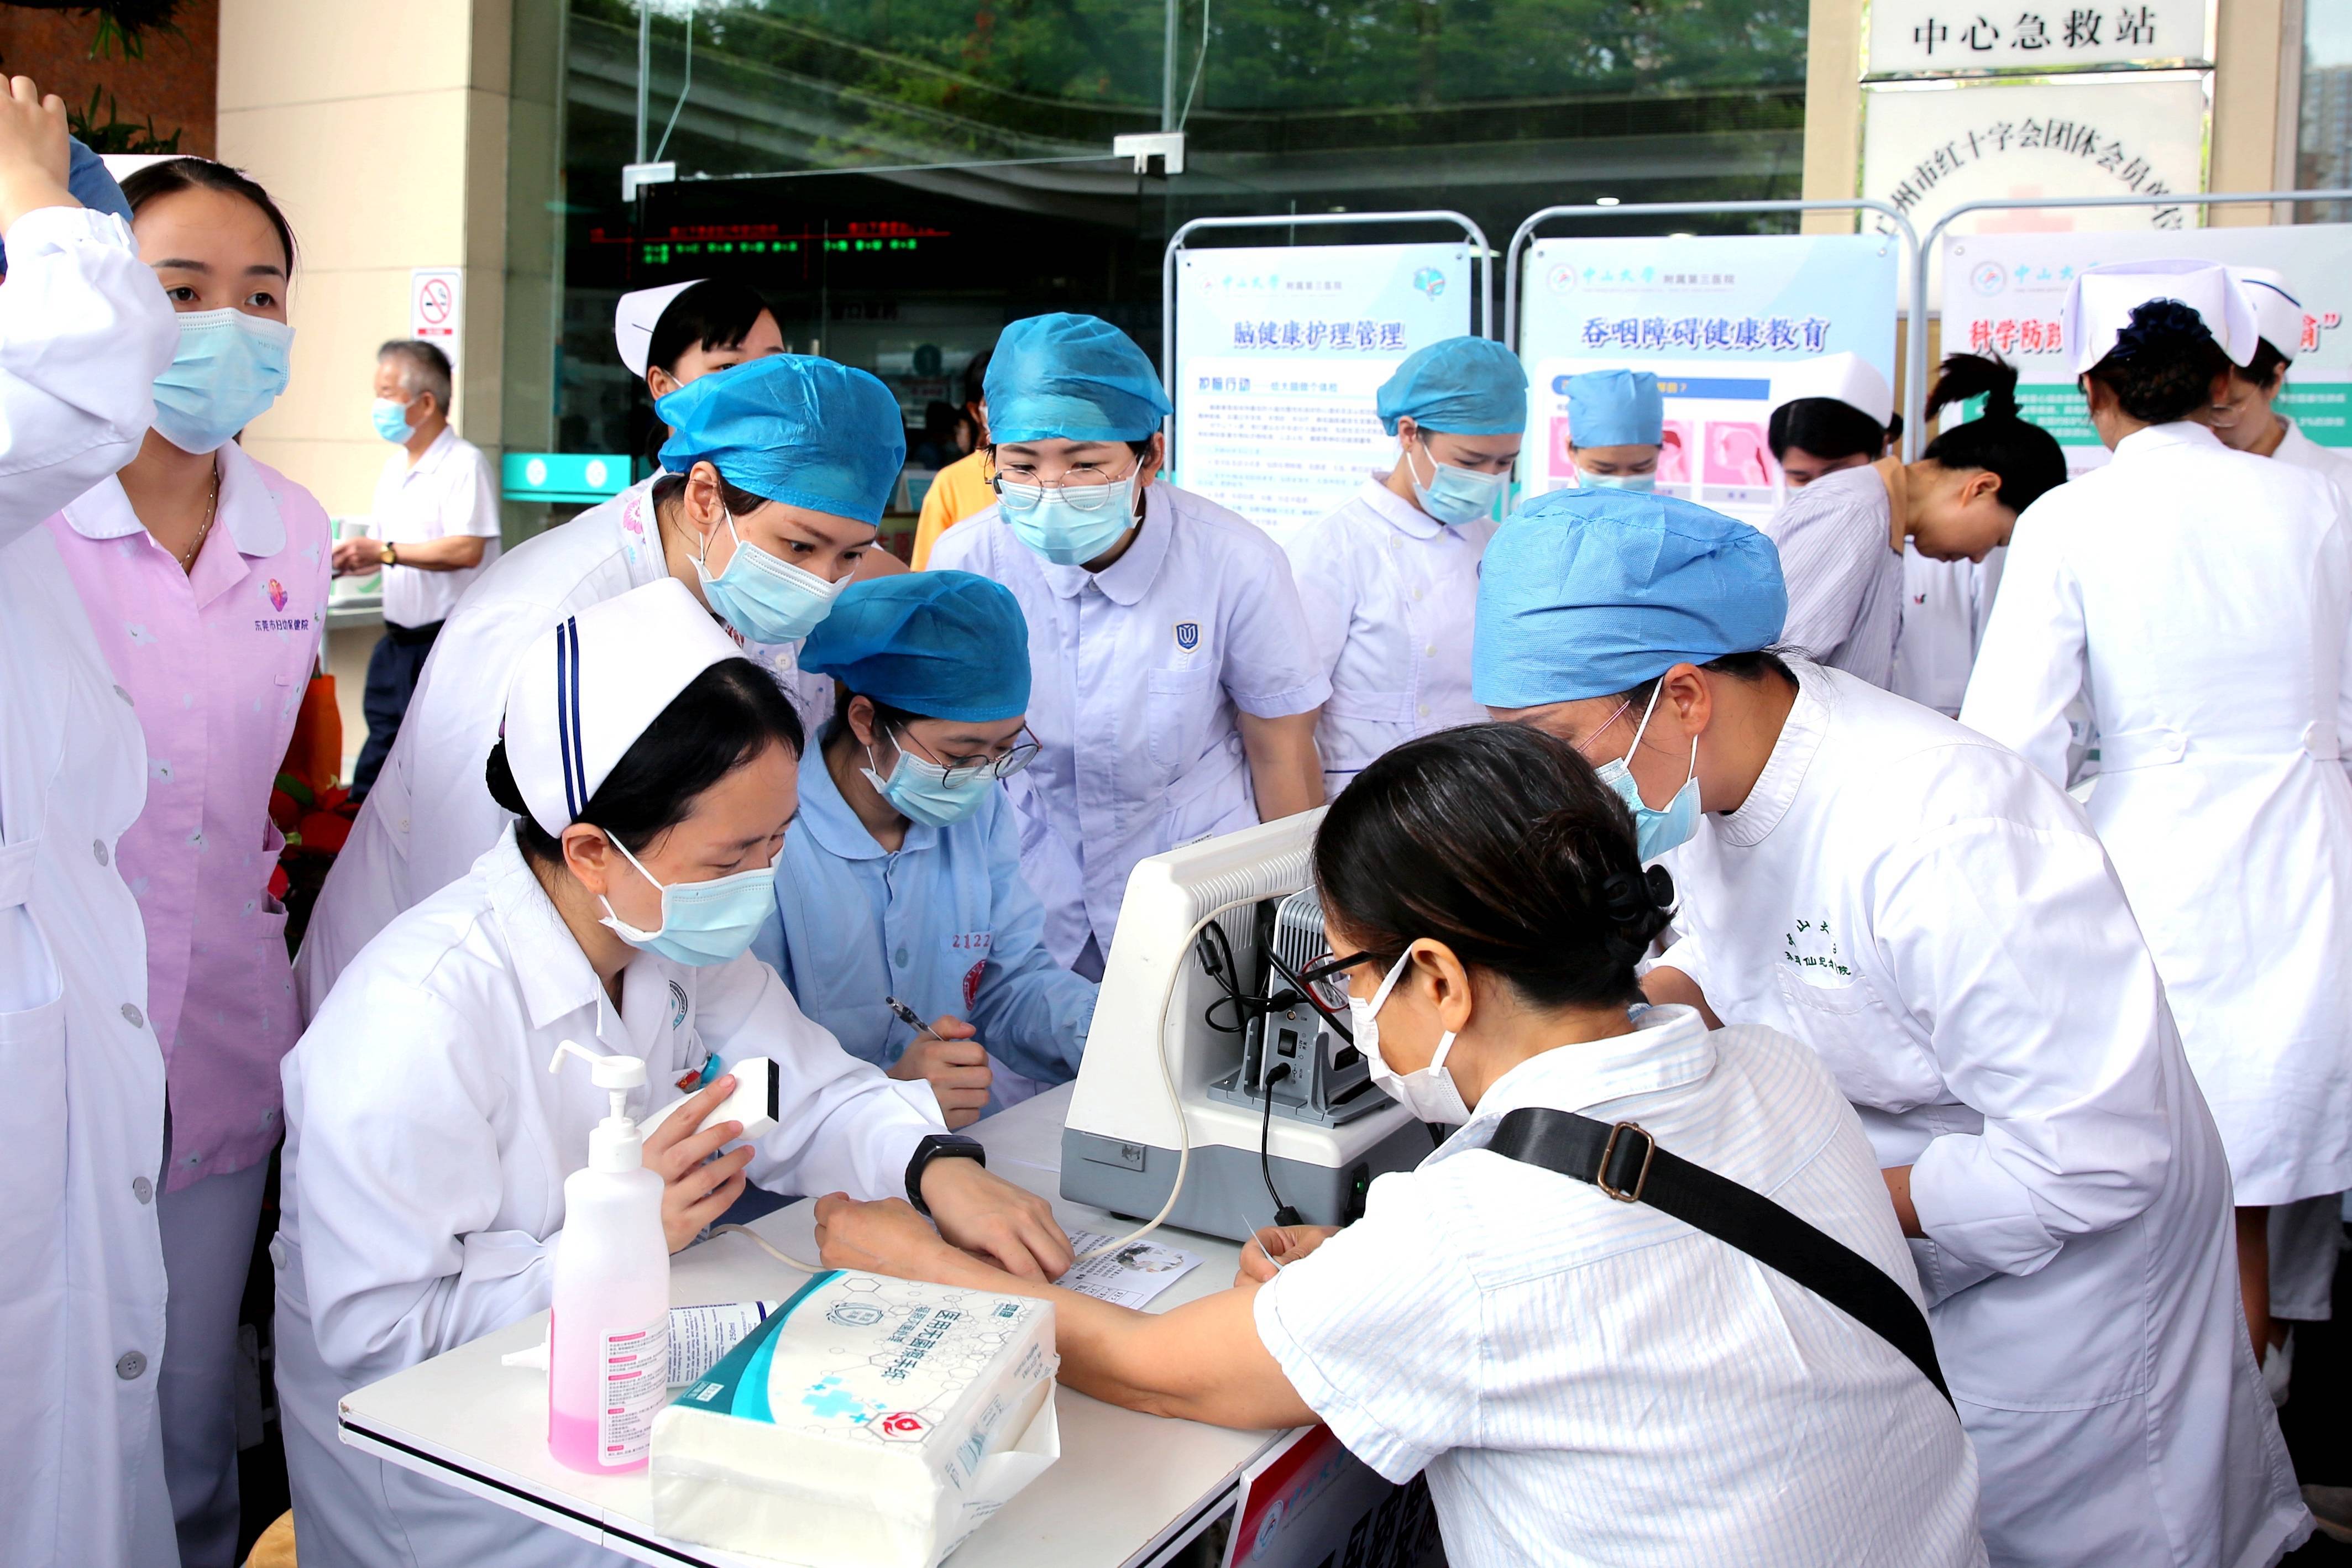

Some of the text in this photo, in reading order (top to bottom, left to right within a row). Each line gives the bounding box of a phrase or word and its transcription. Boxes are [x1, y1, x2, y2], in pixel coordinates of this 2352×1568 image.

[1914, 6, 2156, 55] 中心急救站
[1233, 319, 1405, 348] 脑健康护理管理
[1584, 317, 1829, 349] 吞咽障碍健康教育
[255, 619, 308, 631] 东莞市妇幼保健院
[952, 934, 991, 949] 2122
[729, 1322, 737, 1341] 250ml
[884, 1310, 961, 1380] 医用无菌擦手纸
